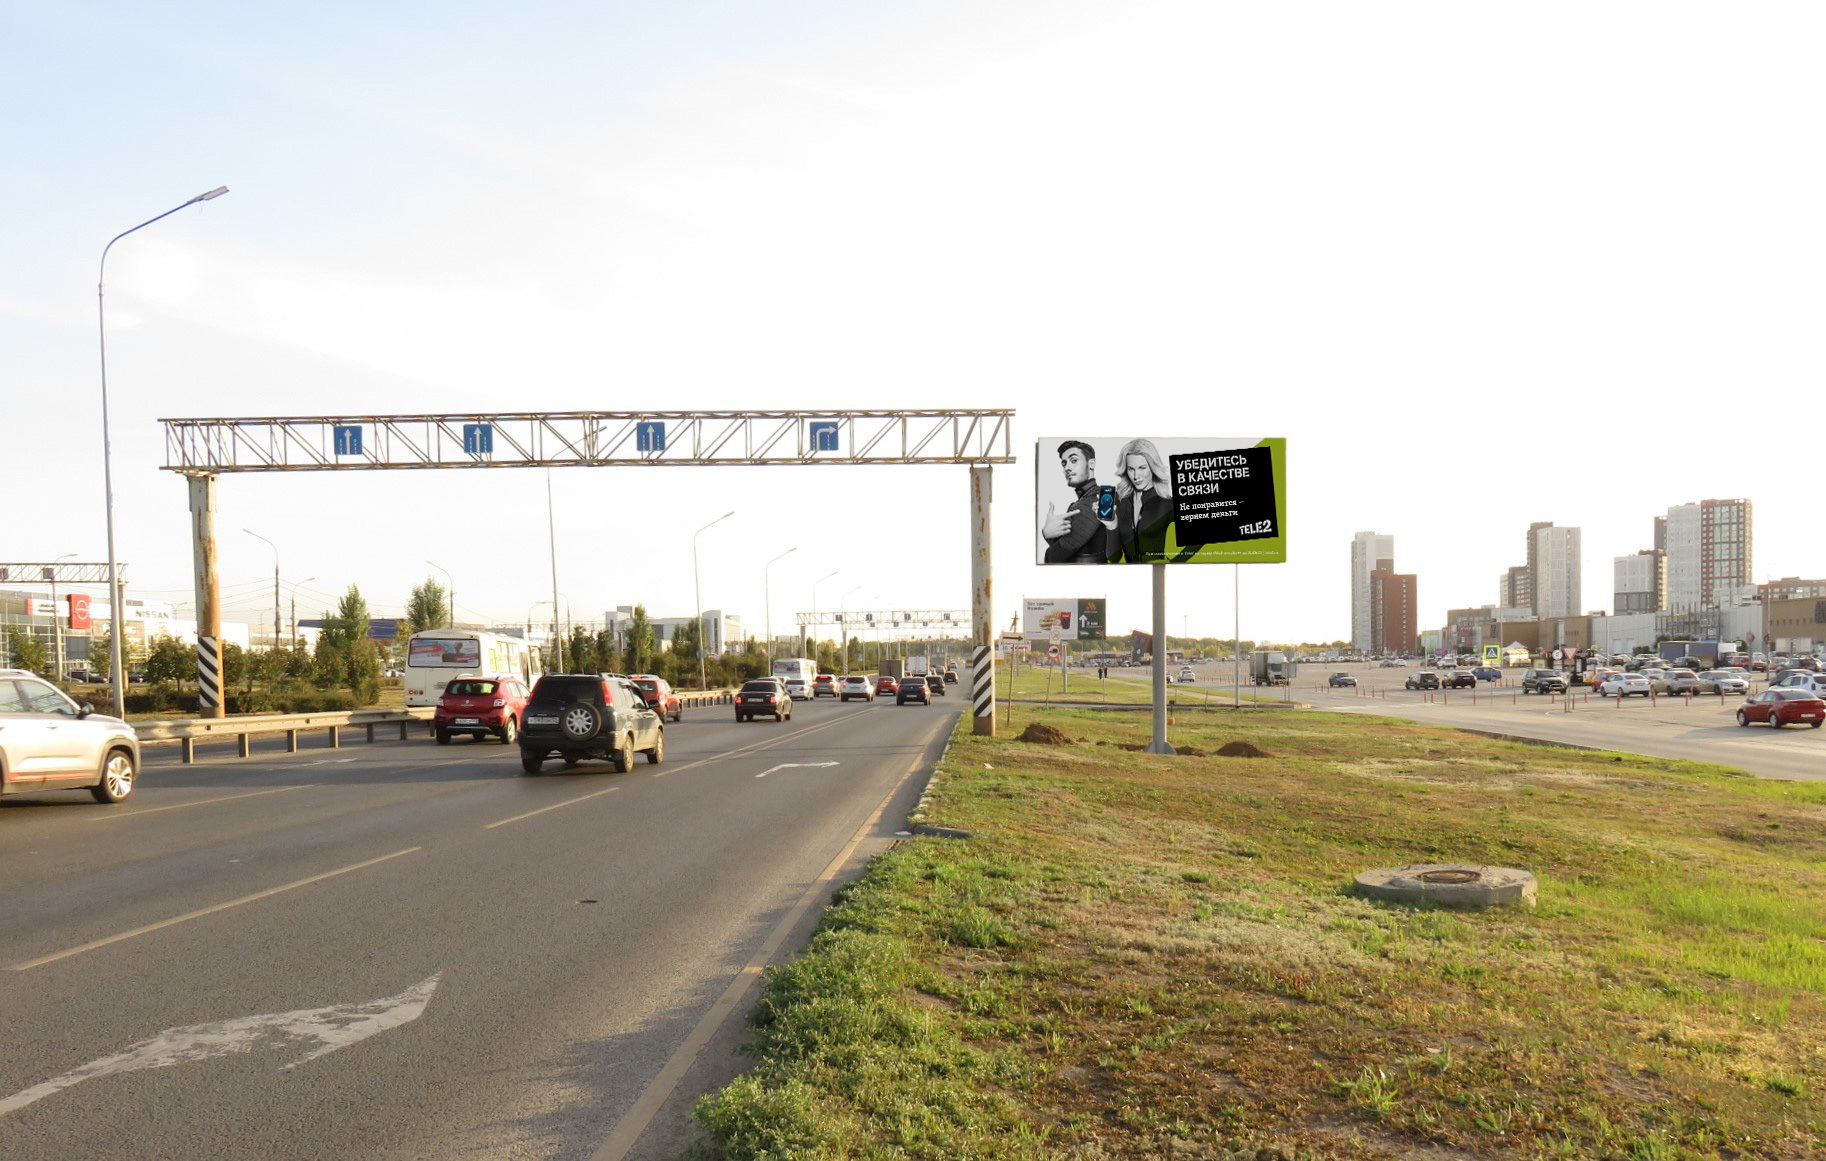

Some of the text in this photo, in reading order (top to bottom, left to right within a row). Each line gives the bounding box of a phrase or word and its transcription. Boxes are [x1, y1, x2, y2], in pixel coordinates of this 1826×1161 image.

[1176, 454, 1247, 470] УБЕДИТЕСЬ
[1177, 467, 1250, 484] В КАЧЕСТВЕ
[1178, 483, 1219, 496] СВЯЗИ
[1192, 500, 1237, 510] понравится
[1180, 510, 1238, 522] вернем деньги
[1239, 519, 1272, 535] TELE2
[136, 610, 169, 620] NISSAN
